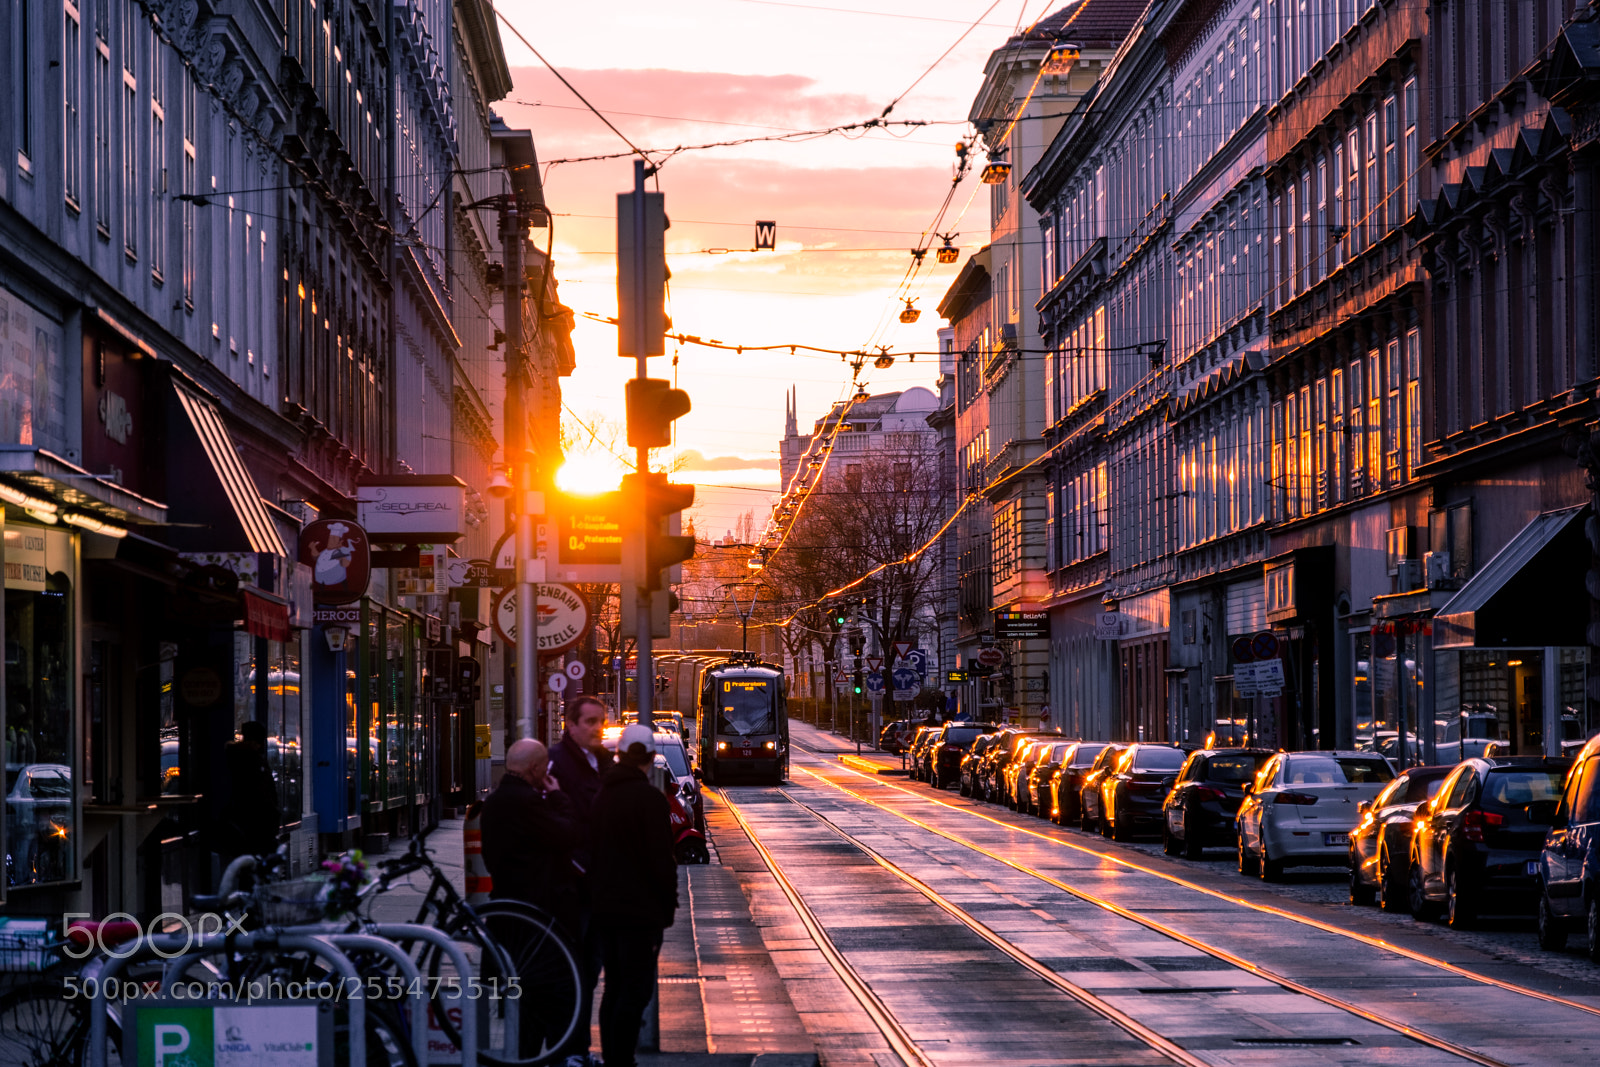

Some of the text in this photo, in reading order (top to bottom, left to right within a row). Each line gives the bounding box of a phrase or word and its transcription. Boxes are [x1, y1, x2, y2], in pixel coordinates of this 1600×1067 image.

[756, 225, 775, 246] W
[380, 502, 452, 511] SECUREAL
[471, 567, 495, 578] STYL
[312, 610, 360, 621] PIEROGI
[555, 677, 561, 688] 1
[154, 1024, 190, 1067] P
[217, 1043, 252, 1053] UNIQA
